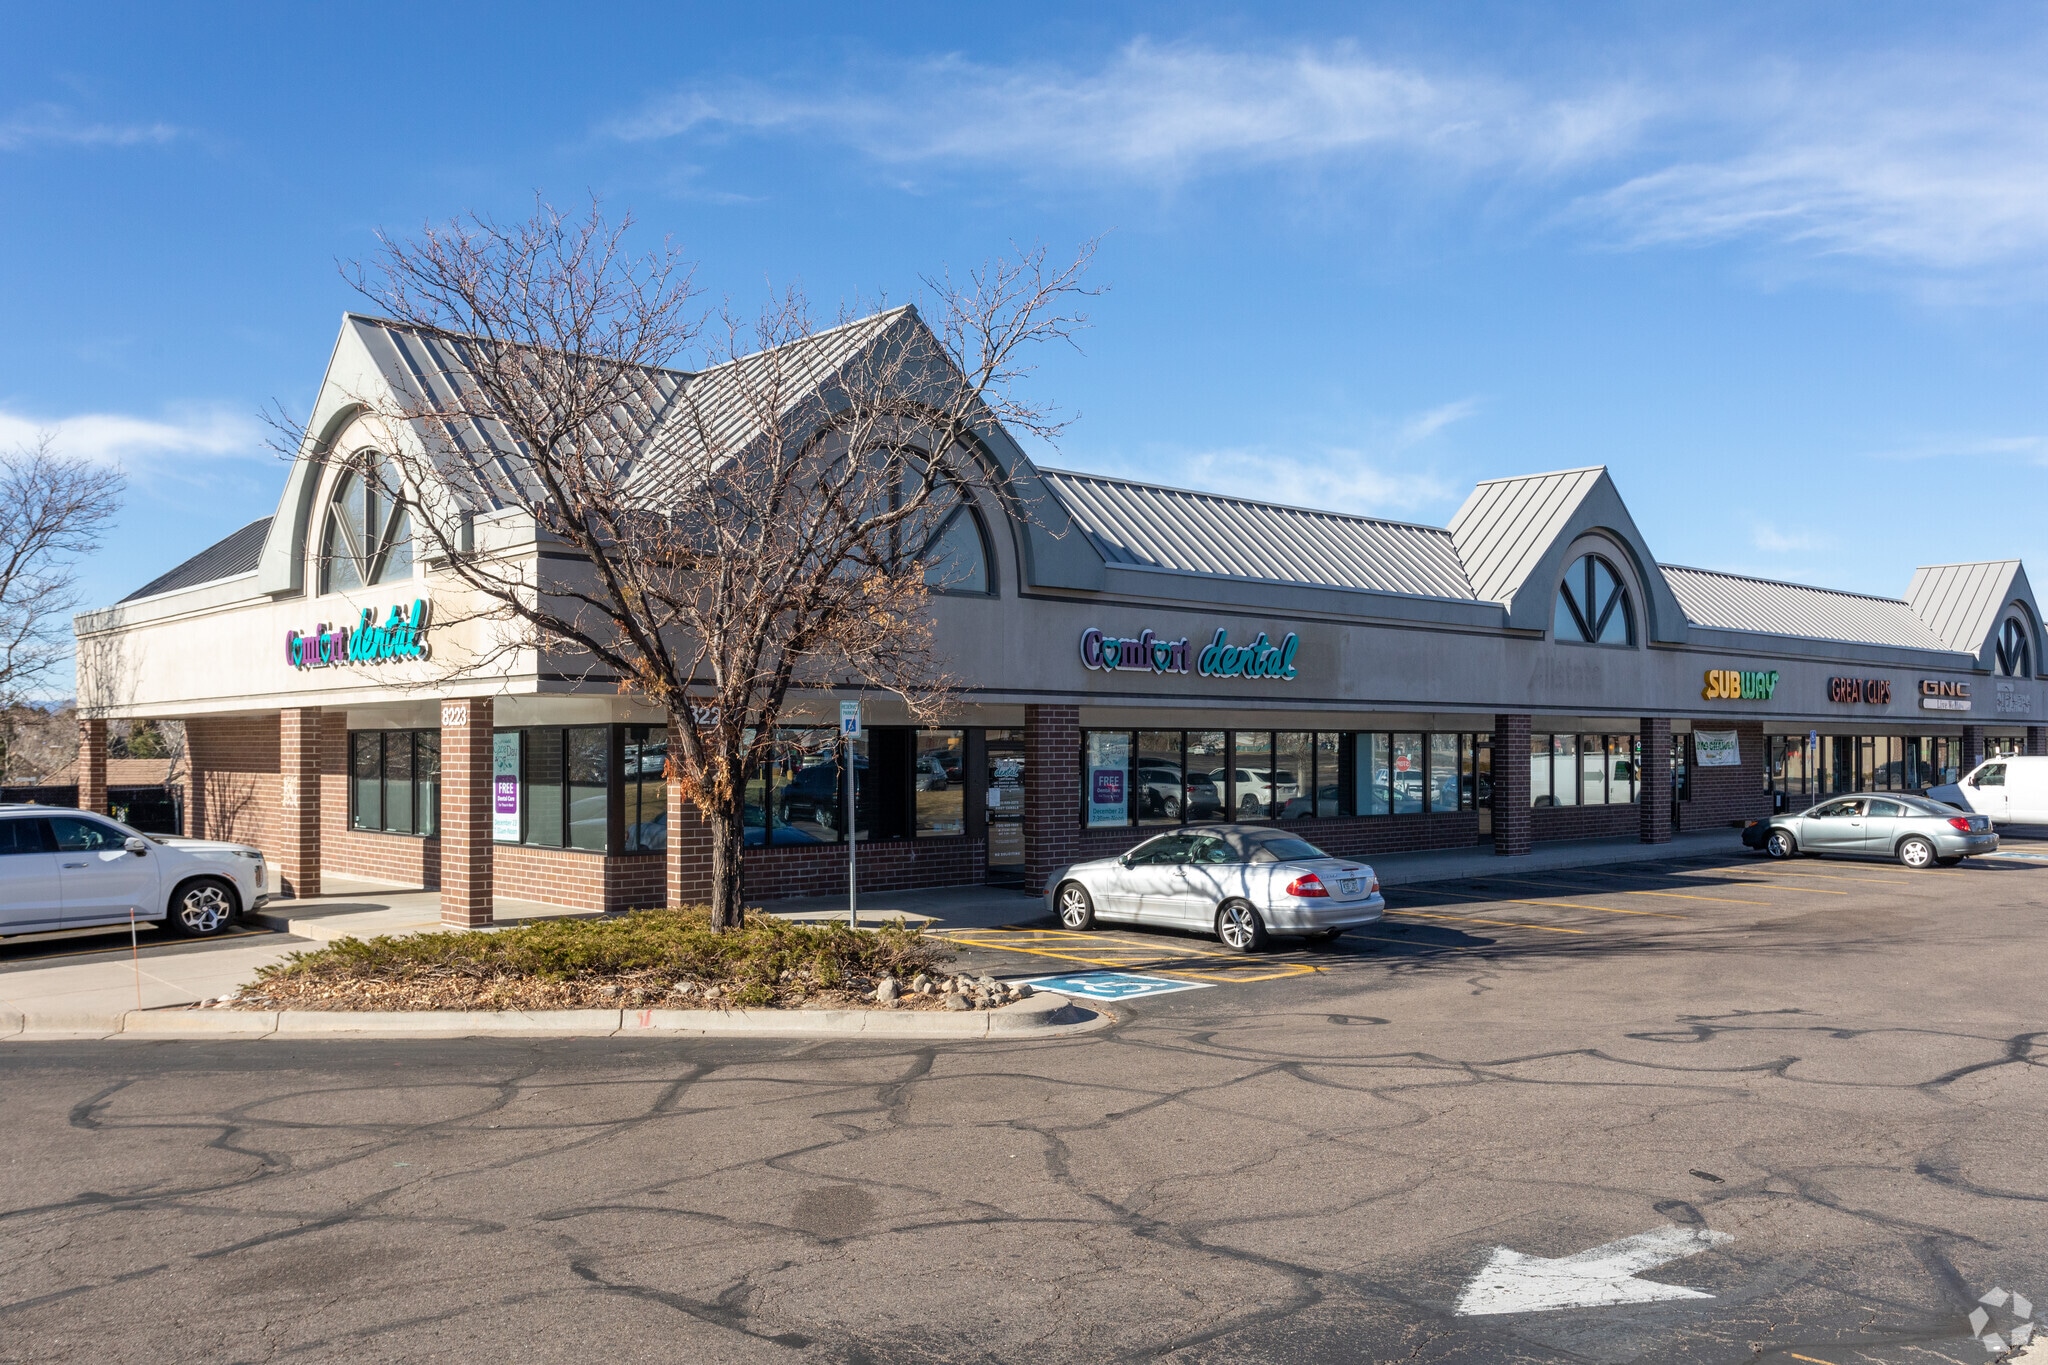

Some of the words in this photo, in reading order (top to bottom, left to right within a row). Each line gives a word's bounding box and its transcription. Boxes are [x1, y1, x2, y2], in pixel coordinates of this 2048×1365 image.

[286, 622, 349, 667] Comfort
[349, 598, 428, 662] dental
[1081, 627, 1192, 675] Comfort
[1198, 627, 1299, 680] dental
[1702, 669, 1780, 700] SUBWAY
[1828, 677, 1863, 702] GREAT
[1863, 679, 1891, 704] CLIPS
[1920, 679, 1971, 697] GNC
[441, 706, 467, 726] 8223
[498, 782, 514, 794] FREE
[1098, 775, 1120, 787] FREE
